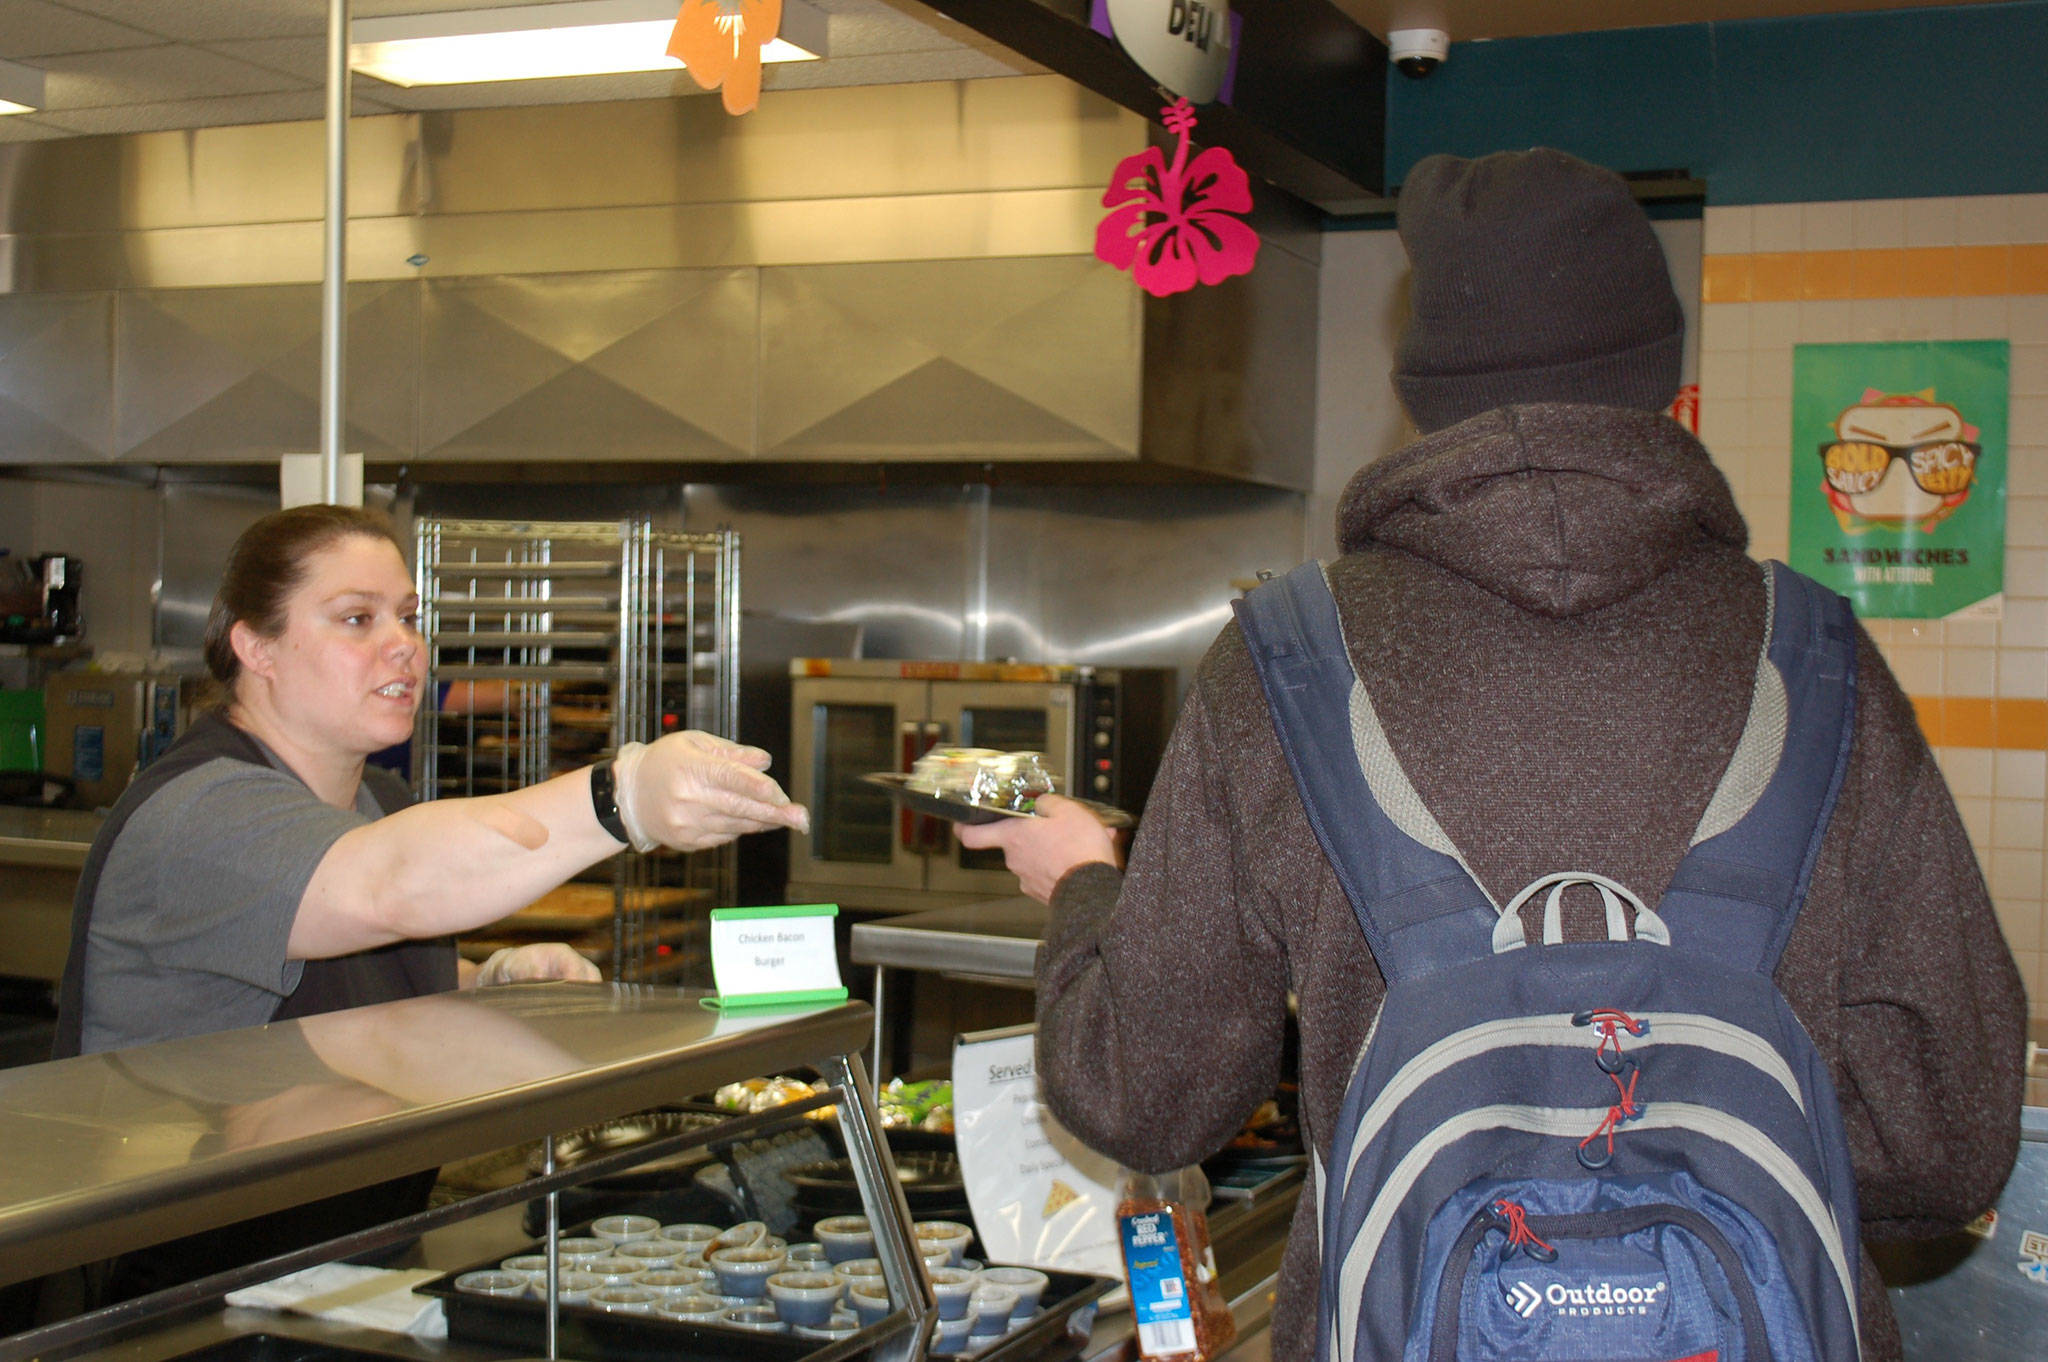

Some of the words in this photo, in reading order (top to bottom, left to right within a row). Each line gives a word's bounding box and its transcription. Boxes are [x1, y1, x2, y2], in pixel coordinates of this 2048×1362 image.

[1168, 0, 1211, 51] DELI
[1825, 442, 1889, 473] BOLD
[1911, 443, 1974, 474] SPICY
[1827, 467, 1883, 494] SAUCY
[1824, 548, 1969, 565] SANDWICHES
[1854, 566, 1882, 584] WITH
[738, 932, 775, 944] Chicken
[777, 931, 806, 943] Bacon
[754, 955, 785, 969] Burger
[988, 1059, 1032, 1081] Served
[1136, 1223, 1158, 1235] RED
[1558, 1306, 1647, 1316] PRODUCTS
